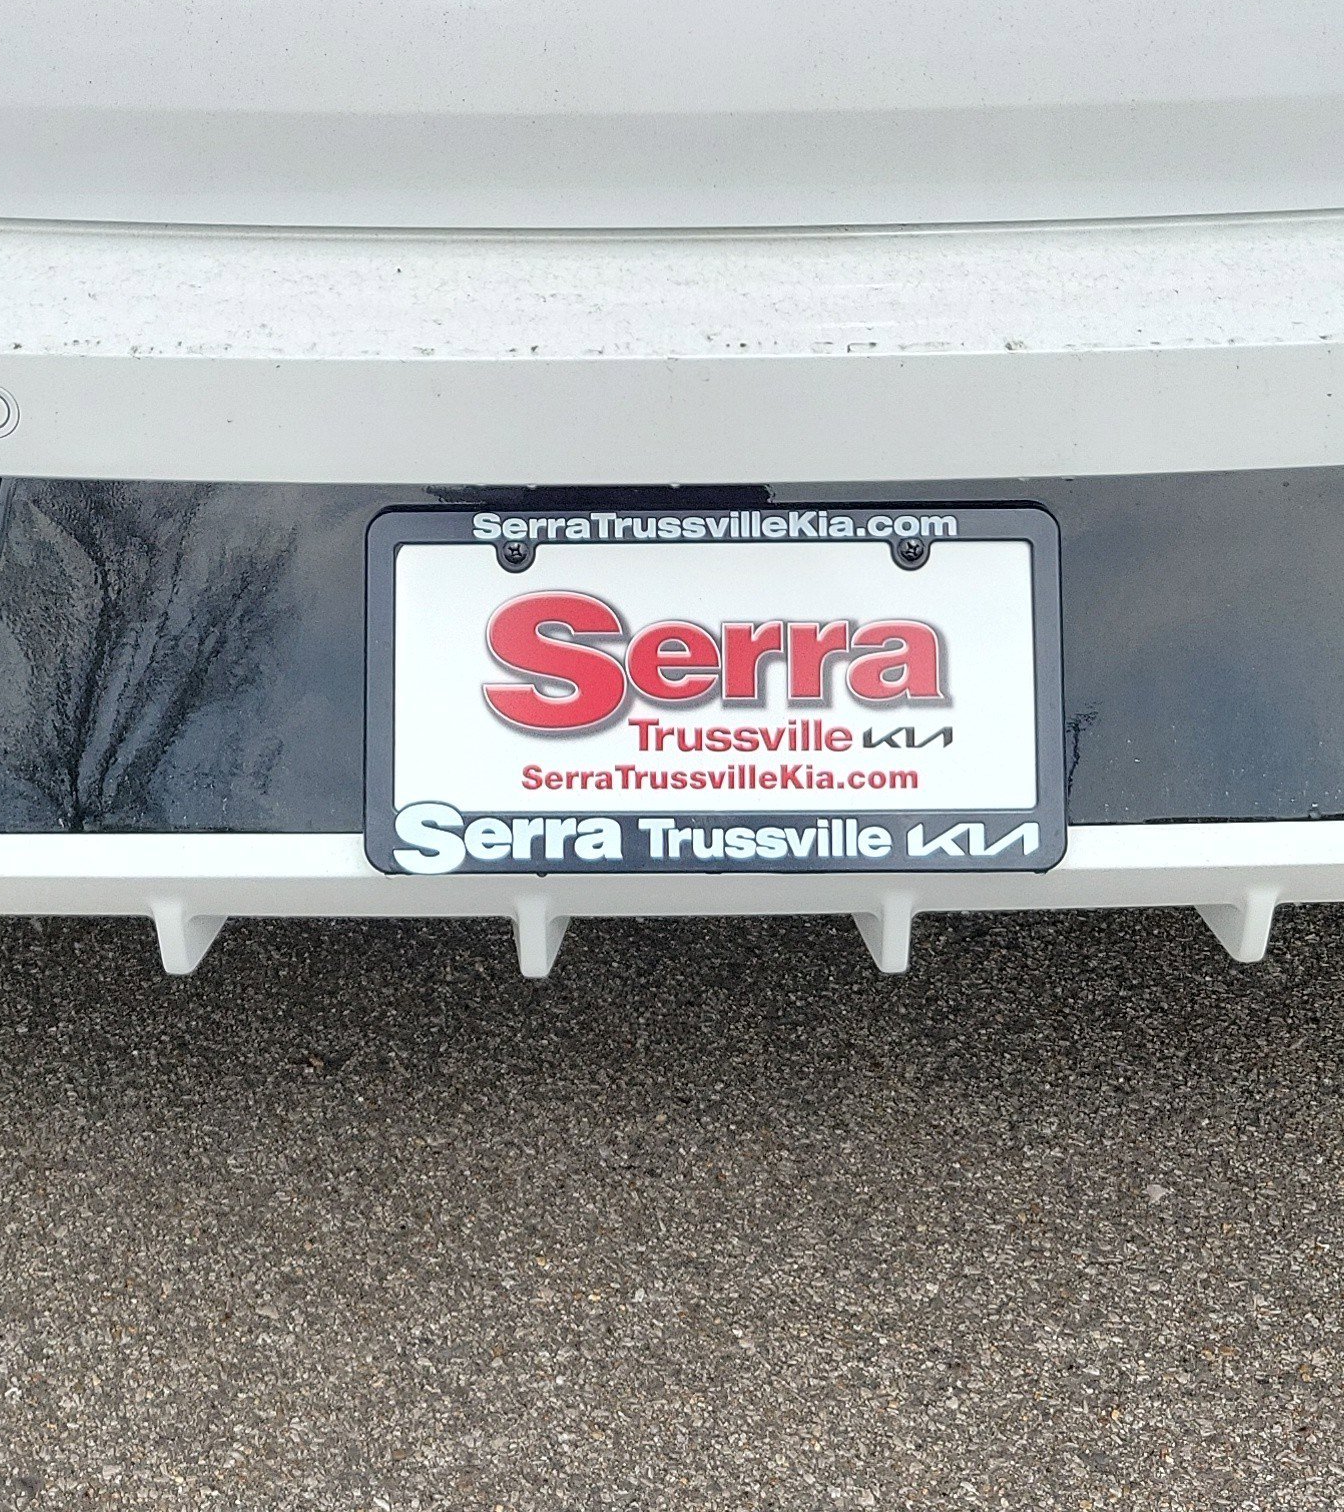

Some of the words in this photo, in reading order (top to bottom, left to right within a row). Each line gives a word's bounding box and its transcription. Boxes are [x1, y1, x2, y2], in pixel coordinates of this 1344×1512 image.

[472, 511, 958, 540] SerraTrussvilleKia.com
[482, 589, 946, 731] Serra
[628, 718, 853, 753] Trussville
[521, 764, 919, 791] SerraTrussvilleKia.com
[393, 801, 623, 875] Serra
[638, 818, 892, 860] Trussville
